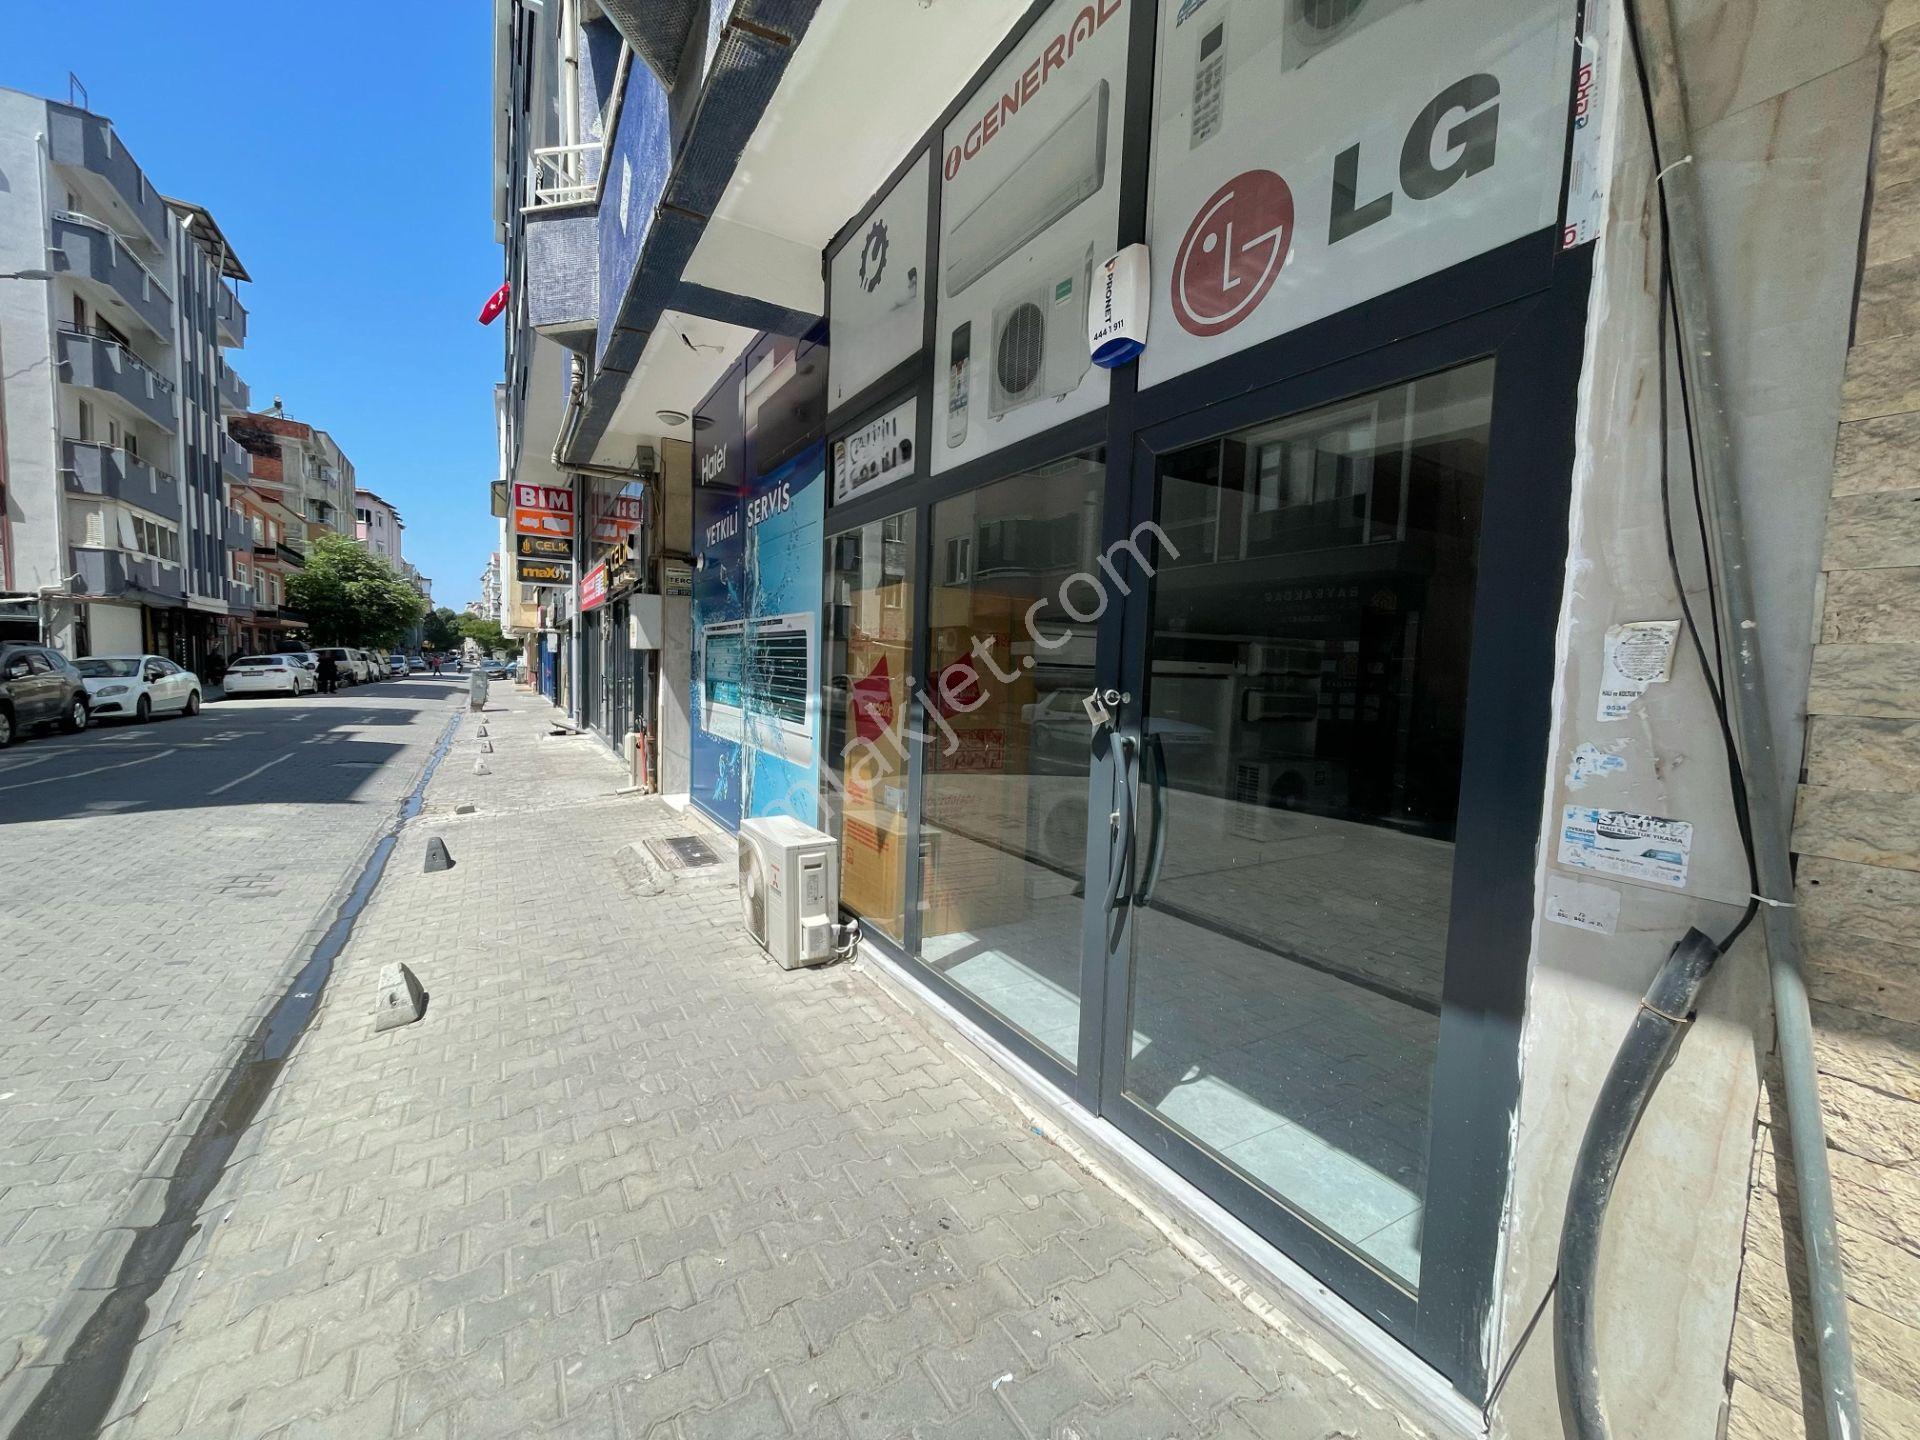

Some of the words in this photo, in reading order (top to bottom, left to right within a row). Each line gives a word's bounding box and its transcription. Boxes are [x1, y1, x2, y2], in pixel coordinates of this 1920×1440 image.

[1327, 72, 1501, 247] LG
[1104, 272, 1114, 323] PRONET
[1093, 326, 1108, 341] 444
[1113, 318, 1125, 331] 911
[701, 441, 728, 486] Haier
[519, 486, 570, 511] BİM
[706, 505, 739, 548] YETKİLİ
[747, 479, 790, 528] SERVİS
